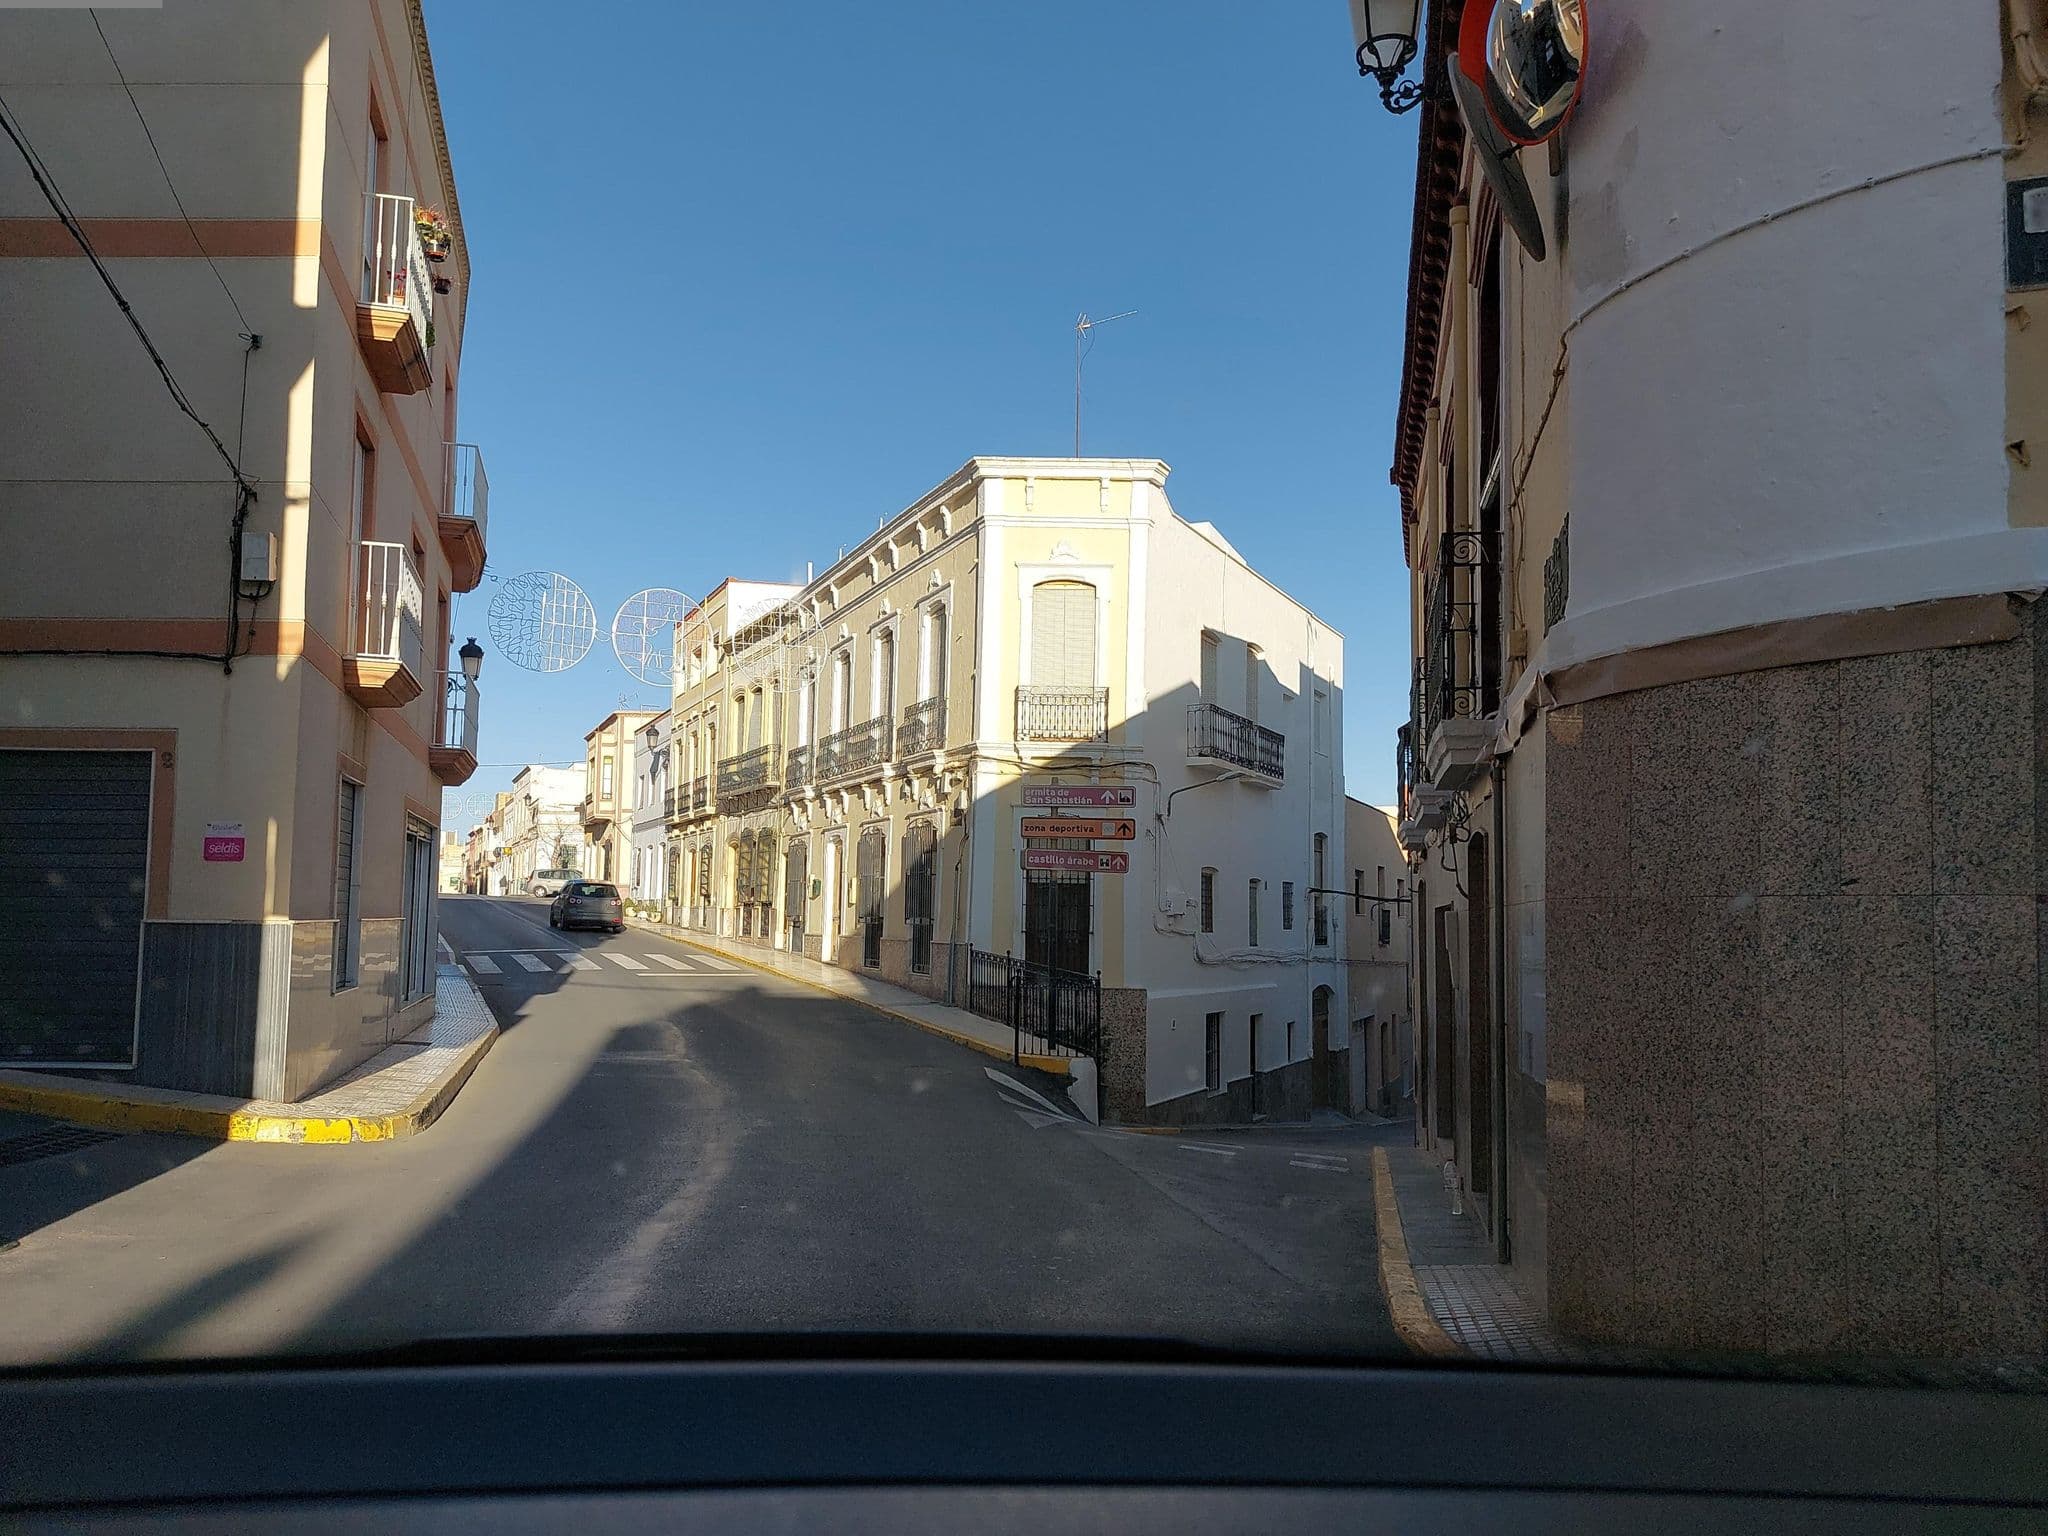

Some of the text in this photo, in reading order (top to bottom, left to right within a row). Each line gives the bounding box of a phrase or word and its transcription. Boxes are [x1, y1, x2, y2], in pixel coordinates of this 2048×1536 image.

[1025, 788, 1069, 796] ermita de
[1025, 796, 1093, 804] San Sebastián
[1049, 824, 1095, 833] deportiva
[208, 842, 241, 854] seldis
[1028, 855, 1094, 866] castillo árabe
